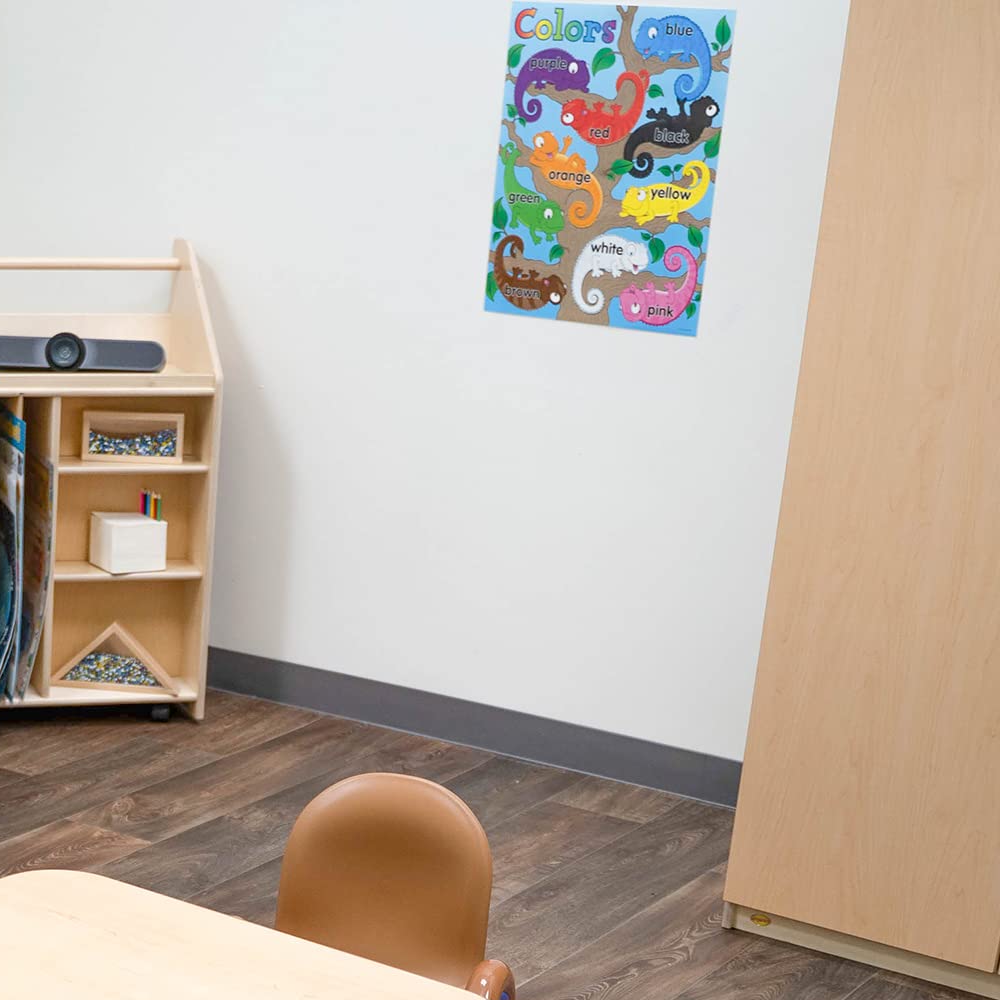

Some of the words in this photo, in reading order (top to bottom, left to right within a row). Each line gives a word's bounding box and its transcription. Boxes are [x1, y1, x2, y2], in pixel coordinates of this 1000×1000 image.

[514, 7, 617, 44] Colors
[665, 23, 693, 37] blue
[529, 57, 568, 71] purple
[589, 126, 610, 139] red
[653, 127, 690, 144] black
[548, 171, 592, 185] orange
[508, 192, 541, 206] green
[650, 186, 692, 202] yellow
[591, 242, 624, 256] white
[504, 285, 541, 299] brown
[647, 304, 674, 318] pink
